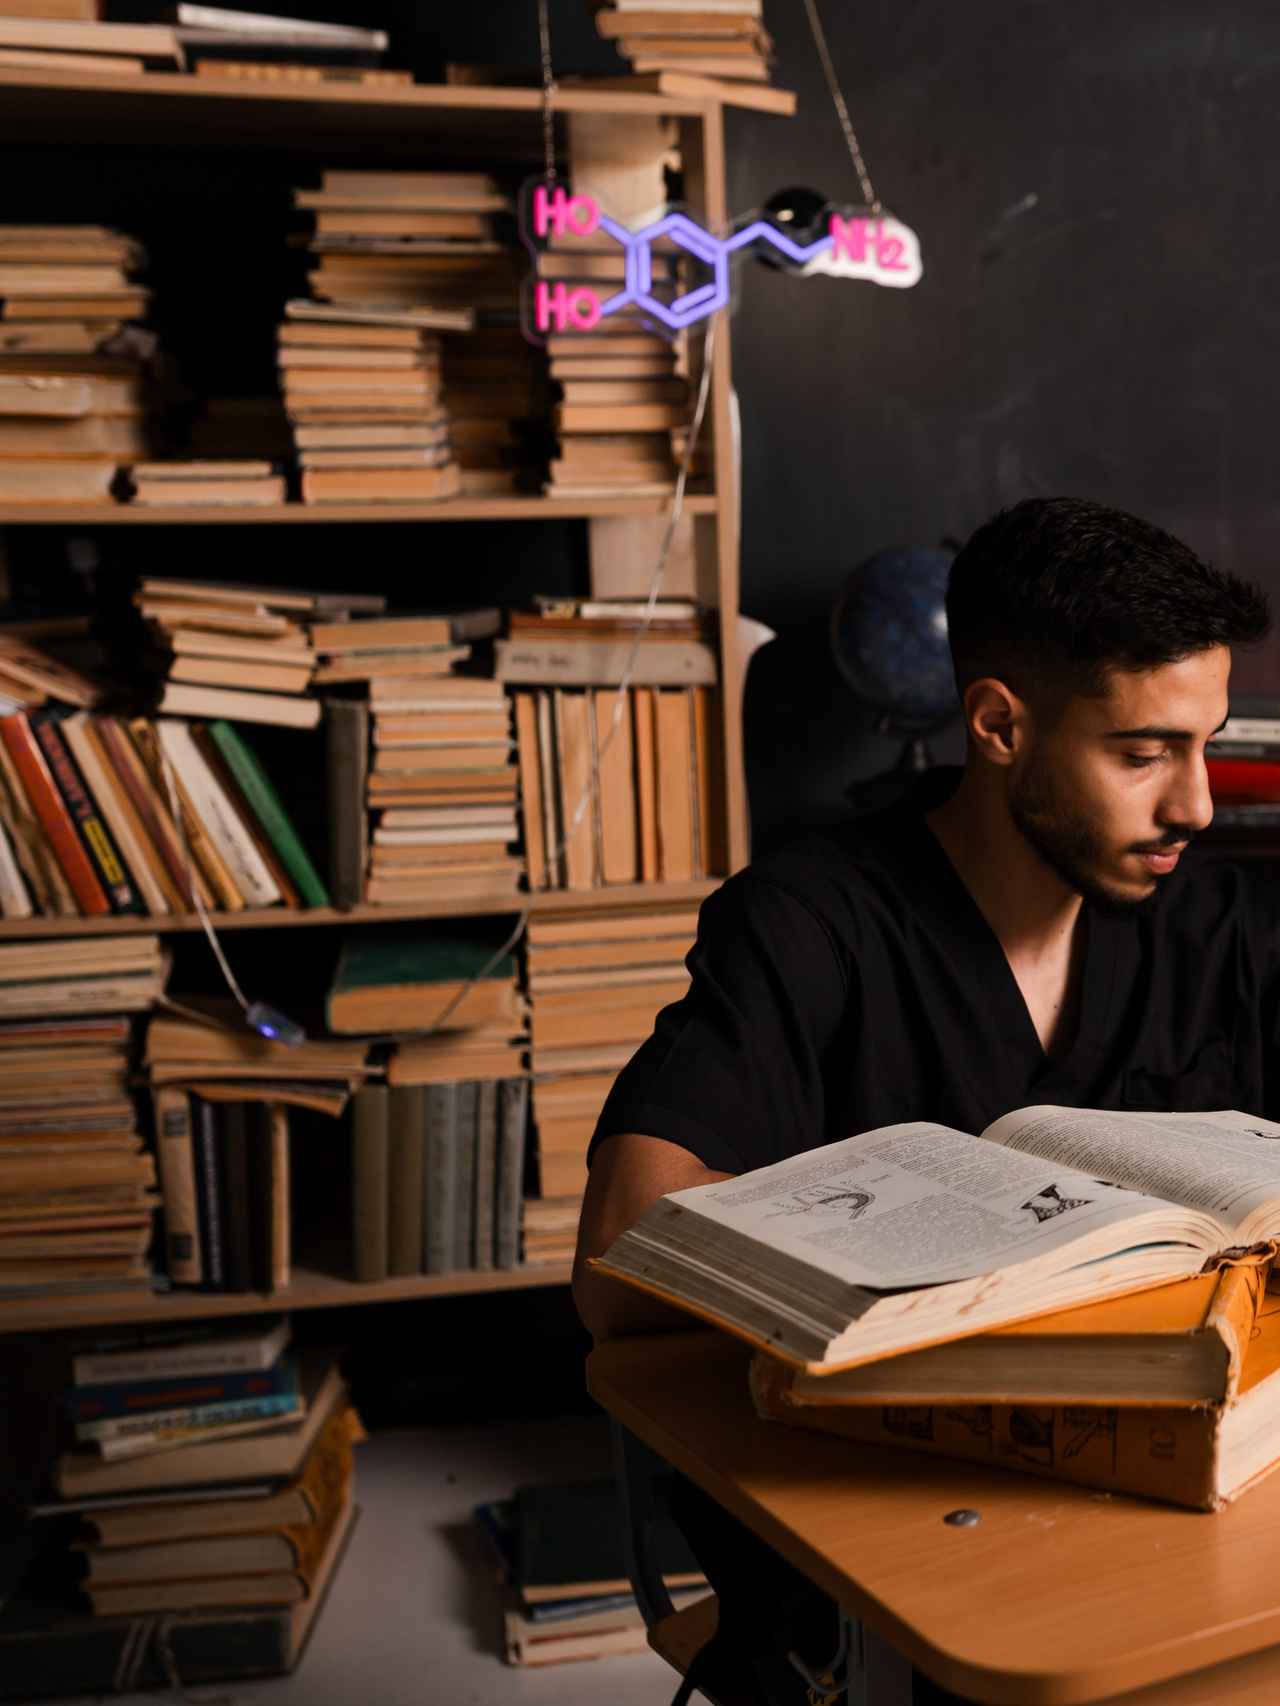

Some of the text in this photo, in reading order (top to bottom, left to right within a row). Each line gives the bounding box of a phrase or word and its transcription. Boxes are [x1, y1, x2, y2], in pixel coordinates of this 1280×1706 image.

[534, 186, 601, 238] HO
[829, 213, 909, 270] NH2
[535, 281, 602, 332] HO
